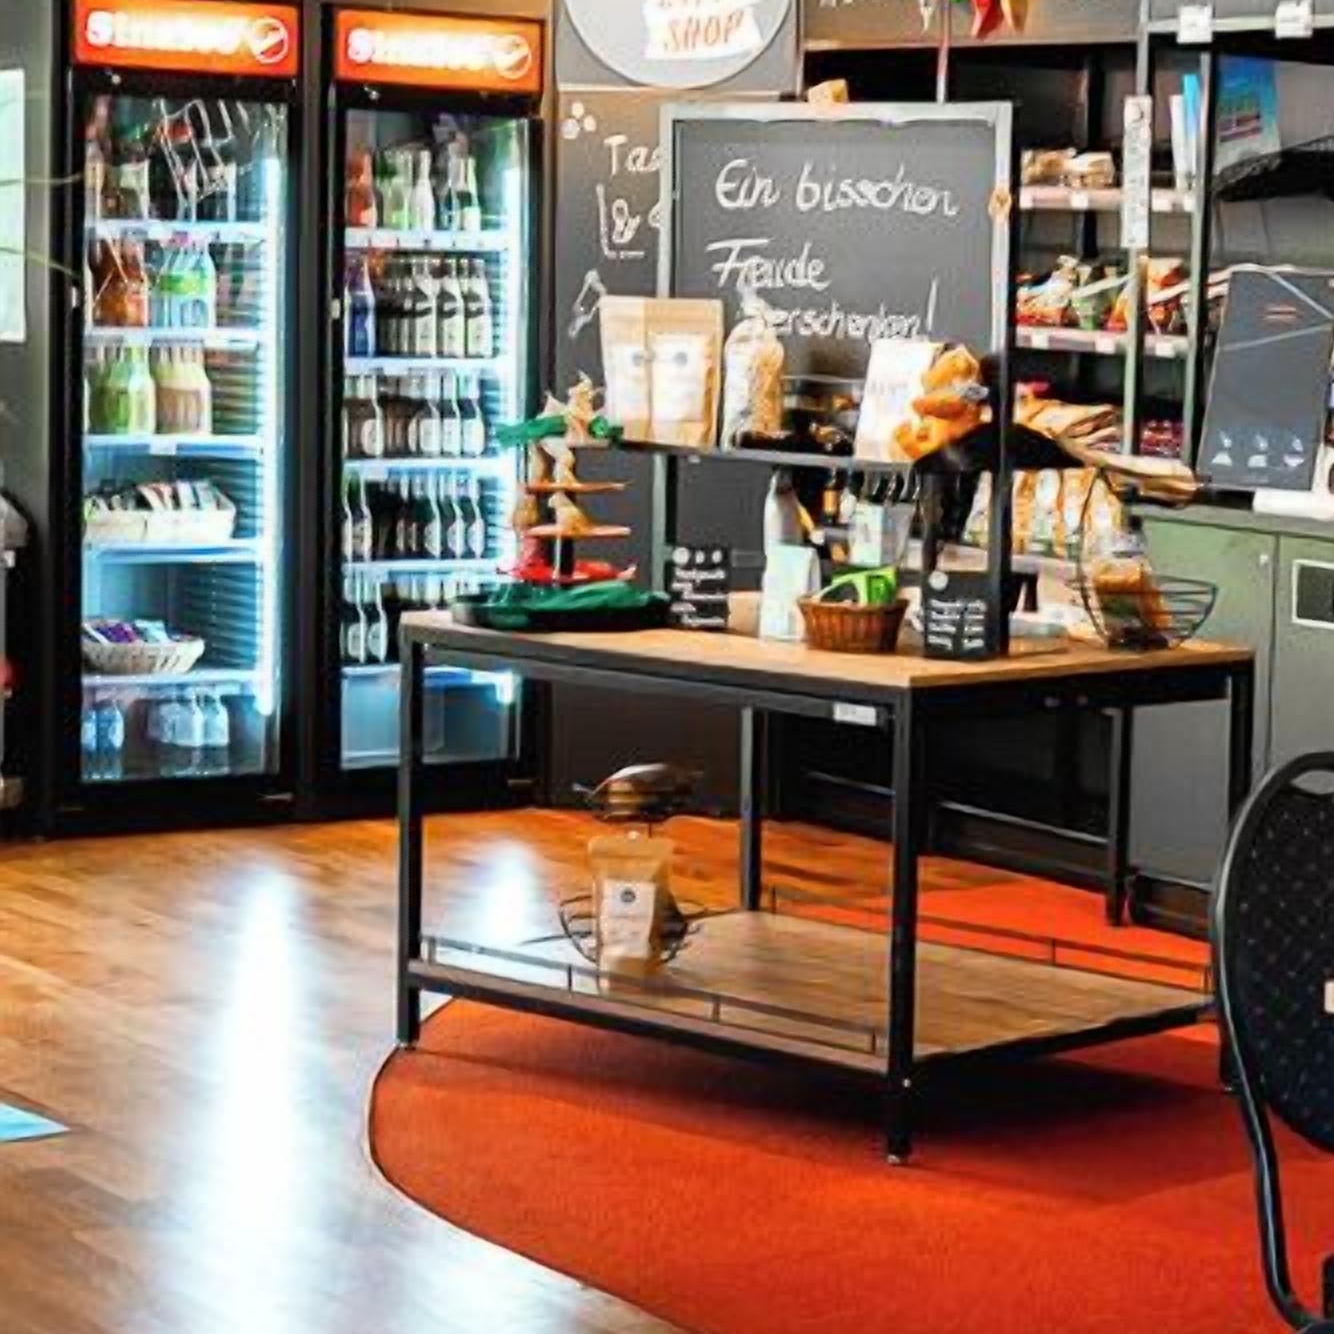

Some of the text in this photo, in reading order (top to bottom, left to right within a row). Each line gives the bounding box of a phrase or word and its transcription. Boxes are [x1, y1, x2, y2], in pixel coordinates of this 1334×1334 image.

[662, 8, 745, 53] SHOP
[715, 159, 960, 217] Ein bisschen
